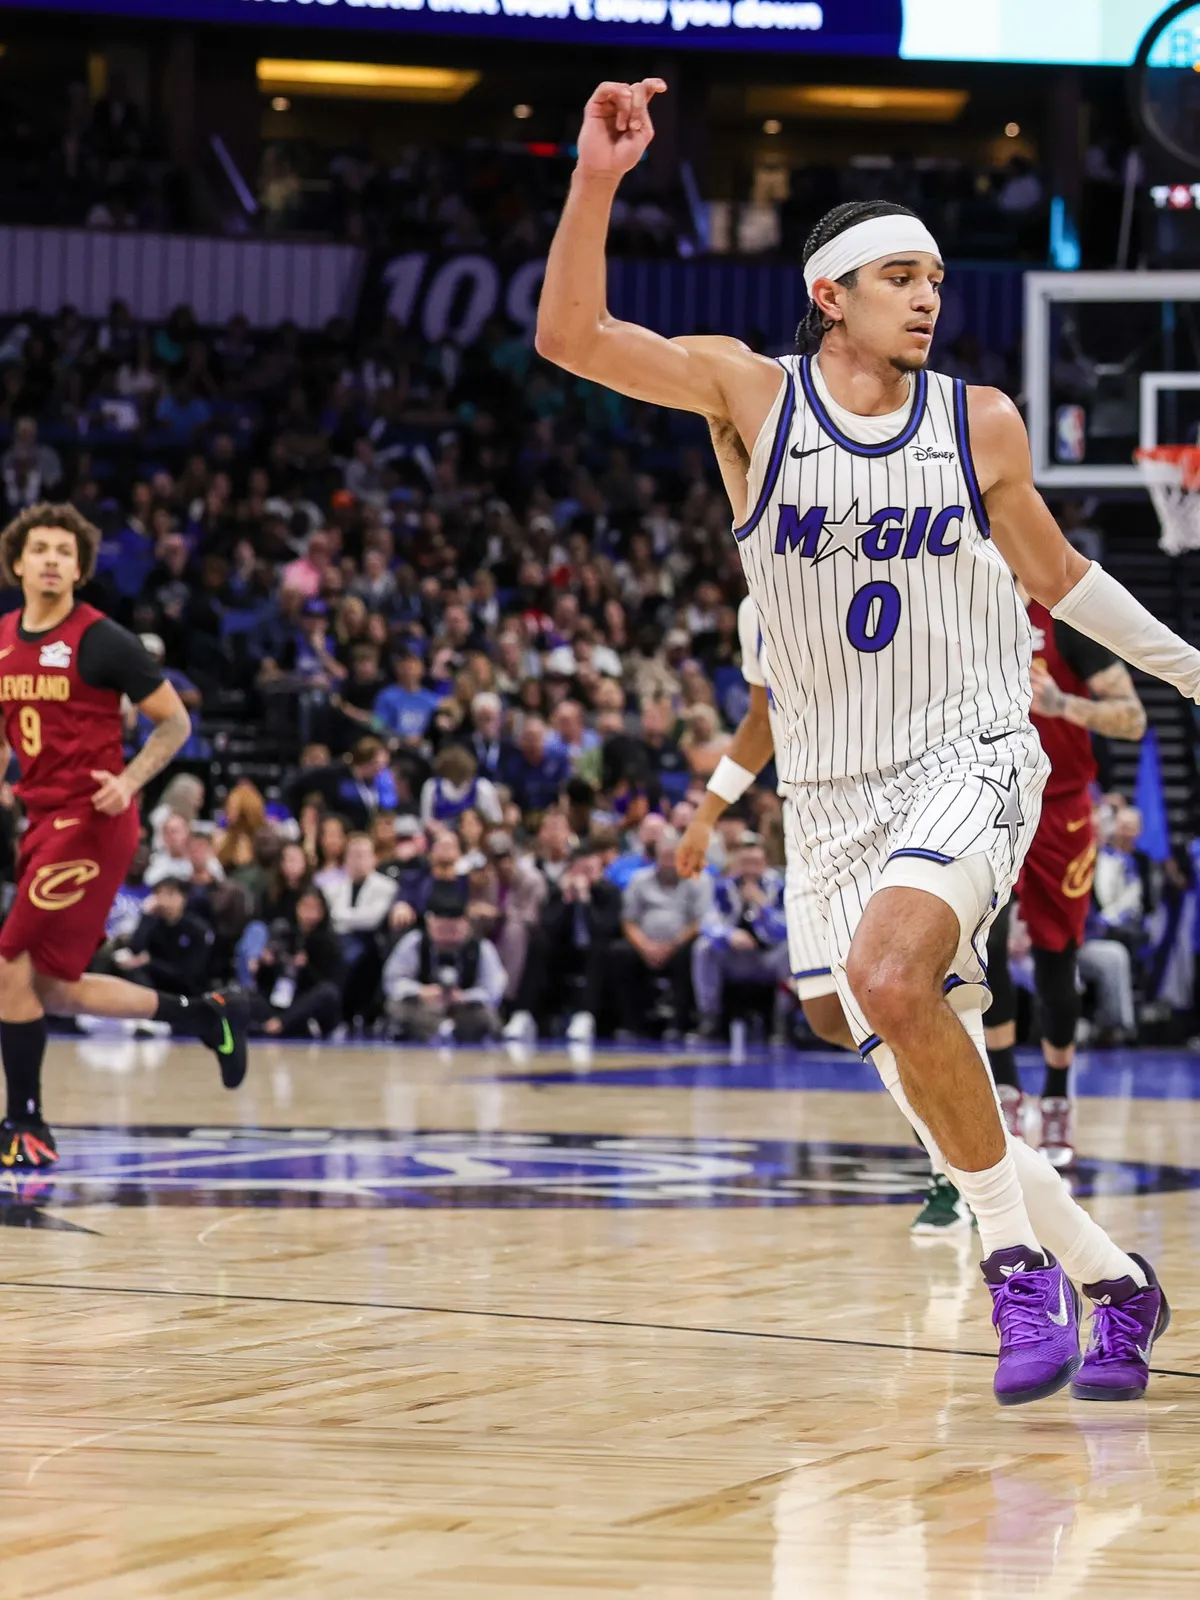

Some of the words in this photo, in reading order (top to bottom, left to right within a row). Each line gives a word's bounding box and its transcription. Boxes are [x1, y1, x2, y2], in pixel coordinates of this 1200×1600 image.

[668, 0, 731, 31] you
[732, 0, 823, 31] down
[909, 445, 956, 464] Disney
[846, 580, 901, 653] 0
[19, 706, 42, 757] 9
